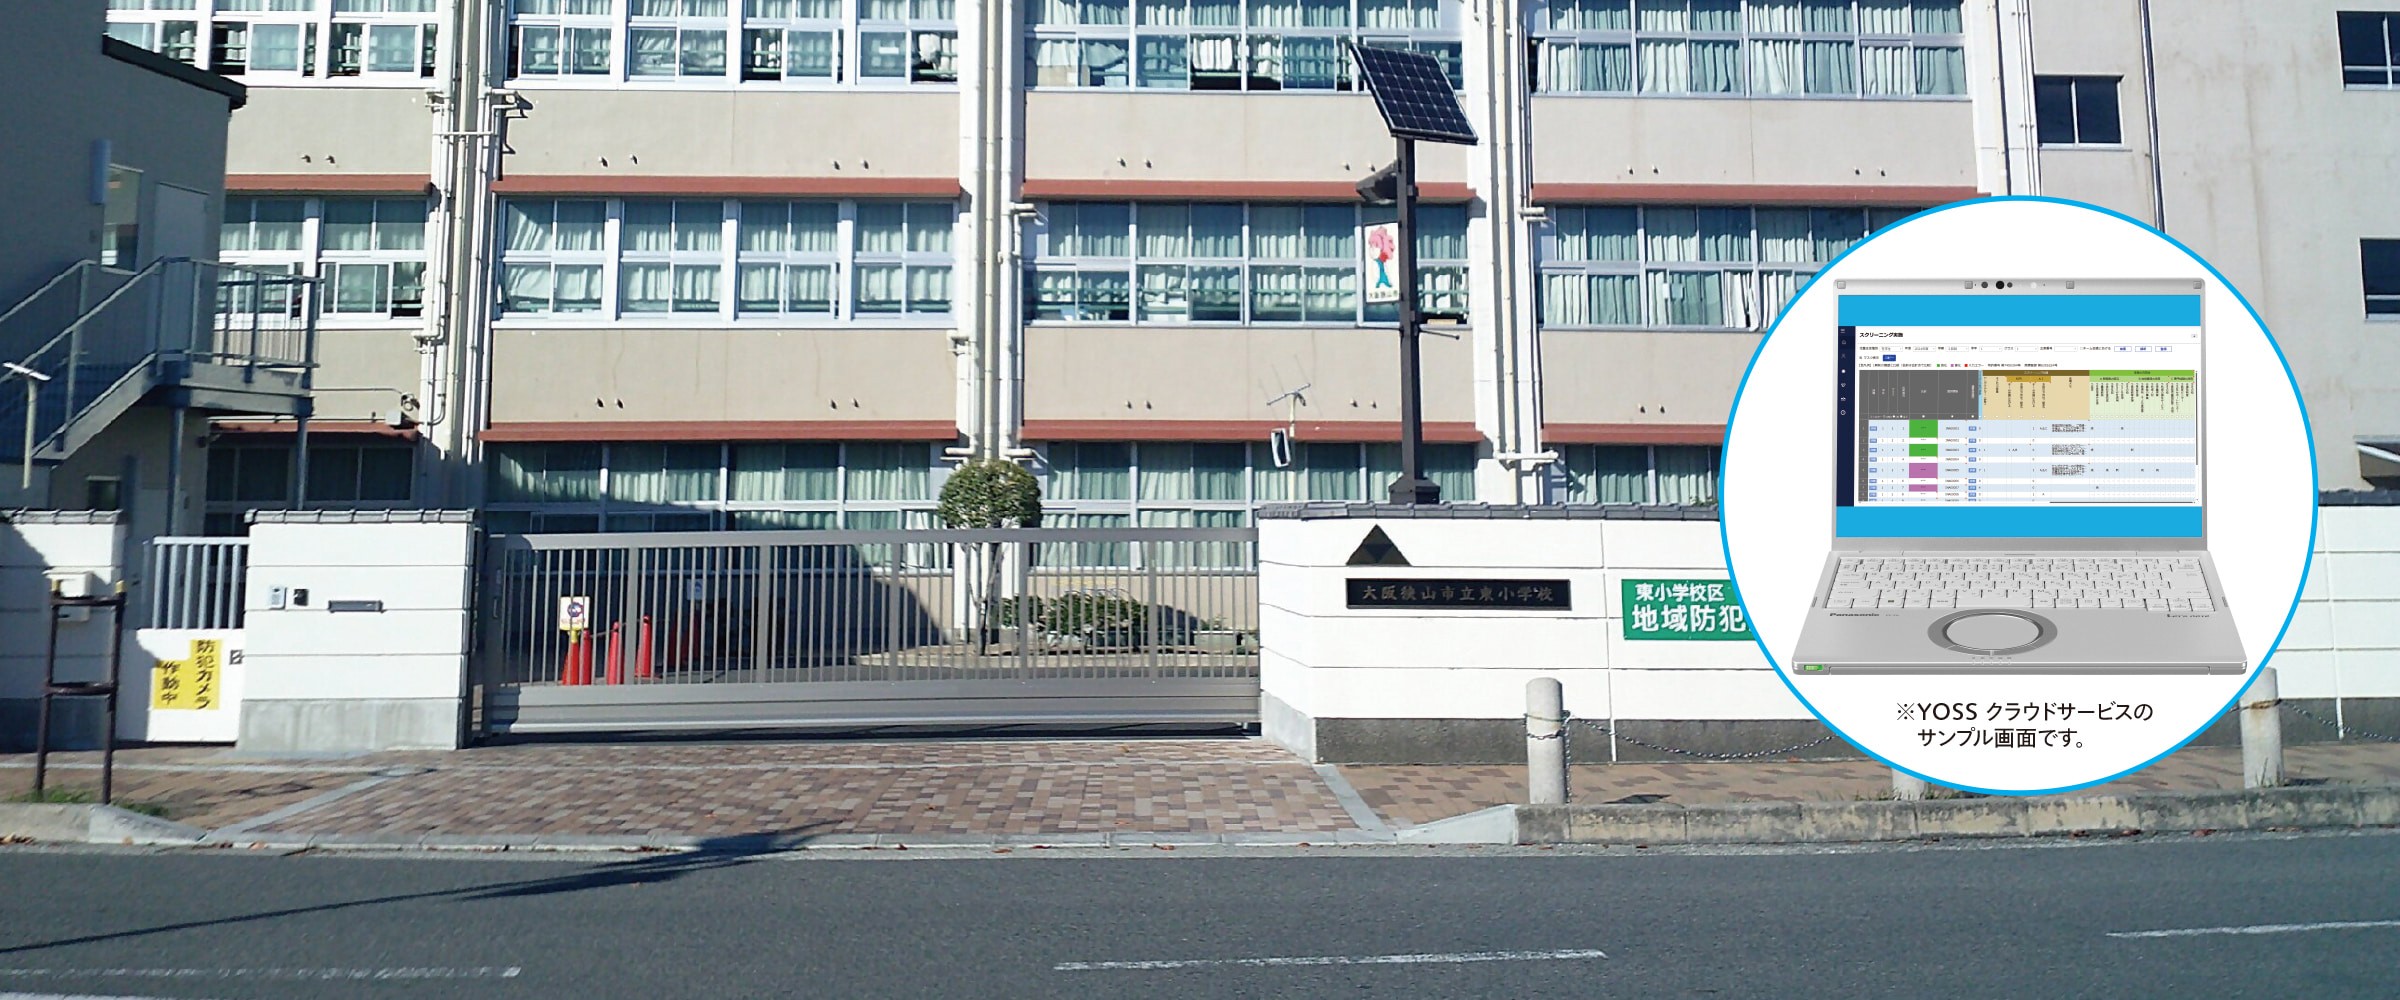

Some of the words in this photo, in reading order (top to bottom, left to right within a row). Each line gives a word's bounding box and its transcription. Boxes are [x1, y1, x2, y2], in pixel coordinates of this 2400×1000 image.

[1634, 582, 1725, 602] 東小学校区
[1631, 604, 1753, 632] 地域防犯
[161, 661, 180, 705] 作動中
[195, 640, 215, 710] 防犯カメラ
